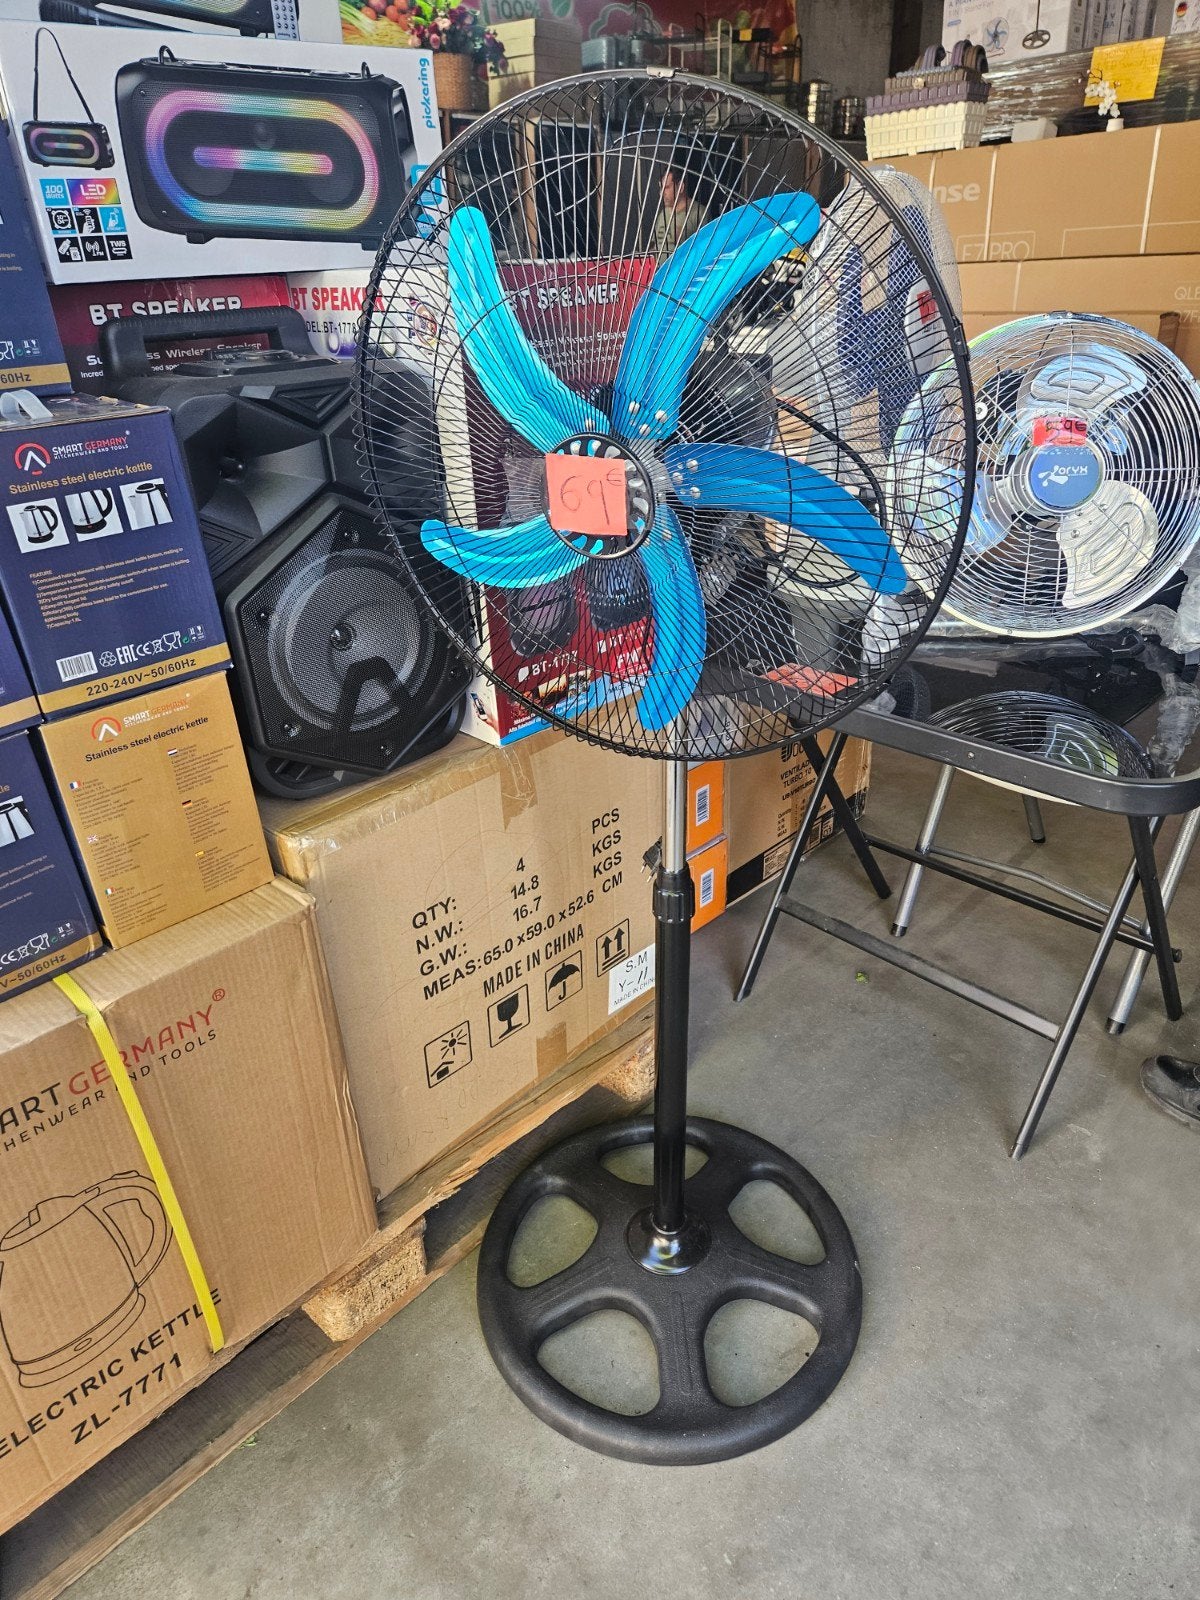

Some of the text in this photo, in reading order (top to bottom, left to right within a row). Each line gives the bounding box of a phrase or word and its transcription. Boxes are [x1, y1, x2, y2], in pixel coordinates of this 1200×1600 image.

[418, 57, 436, 129] pickering
[46, 185, 63, 194] 100
[80, 184, 106, 196] LED
[89, 296, 242, 326] BT SPEAKER
[291, 286, 385, 311] BT SPEAKR
[538, 283, 619, 310] SPEAKER
[0, 372, 32, 384] 60Hz
[52, 436, 128, 455] SMART GERMANY
[9, 462, 153, 494] Stainless steel electric kettle
[1058, 465, 1088, 474] oryx
[87, 657, 196, 696] 220-240V~50/60Hz
[123, 699, 188, 725] SMART GERMANY
[85, 717, 209, 762] Stainless steel electric kettle
[516, 807, 620, 872] 4 PCS
[510, 829, 622, 900] 14.8 KGS
[602, 871, 623, 894] CM
[512, 851, 622, 923] 16.7 KGS
[412, 896, 457, 930] QTY:
[415, 920, 464, 956] N.W.:
[419, 941, 468, 977] G.W.:
[483, 923, 584, 998] MADE IN CHINA
[158, 1029, 216, 1066] TOOLS
[0, 1082, 61, 1134] ART
[0, 1358, 124, 1459] ELECTRIC
[70, 1352, 182, 1445] ZL-7771
